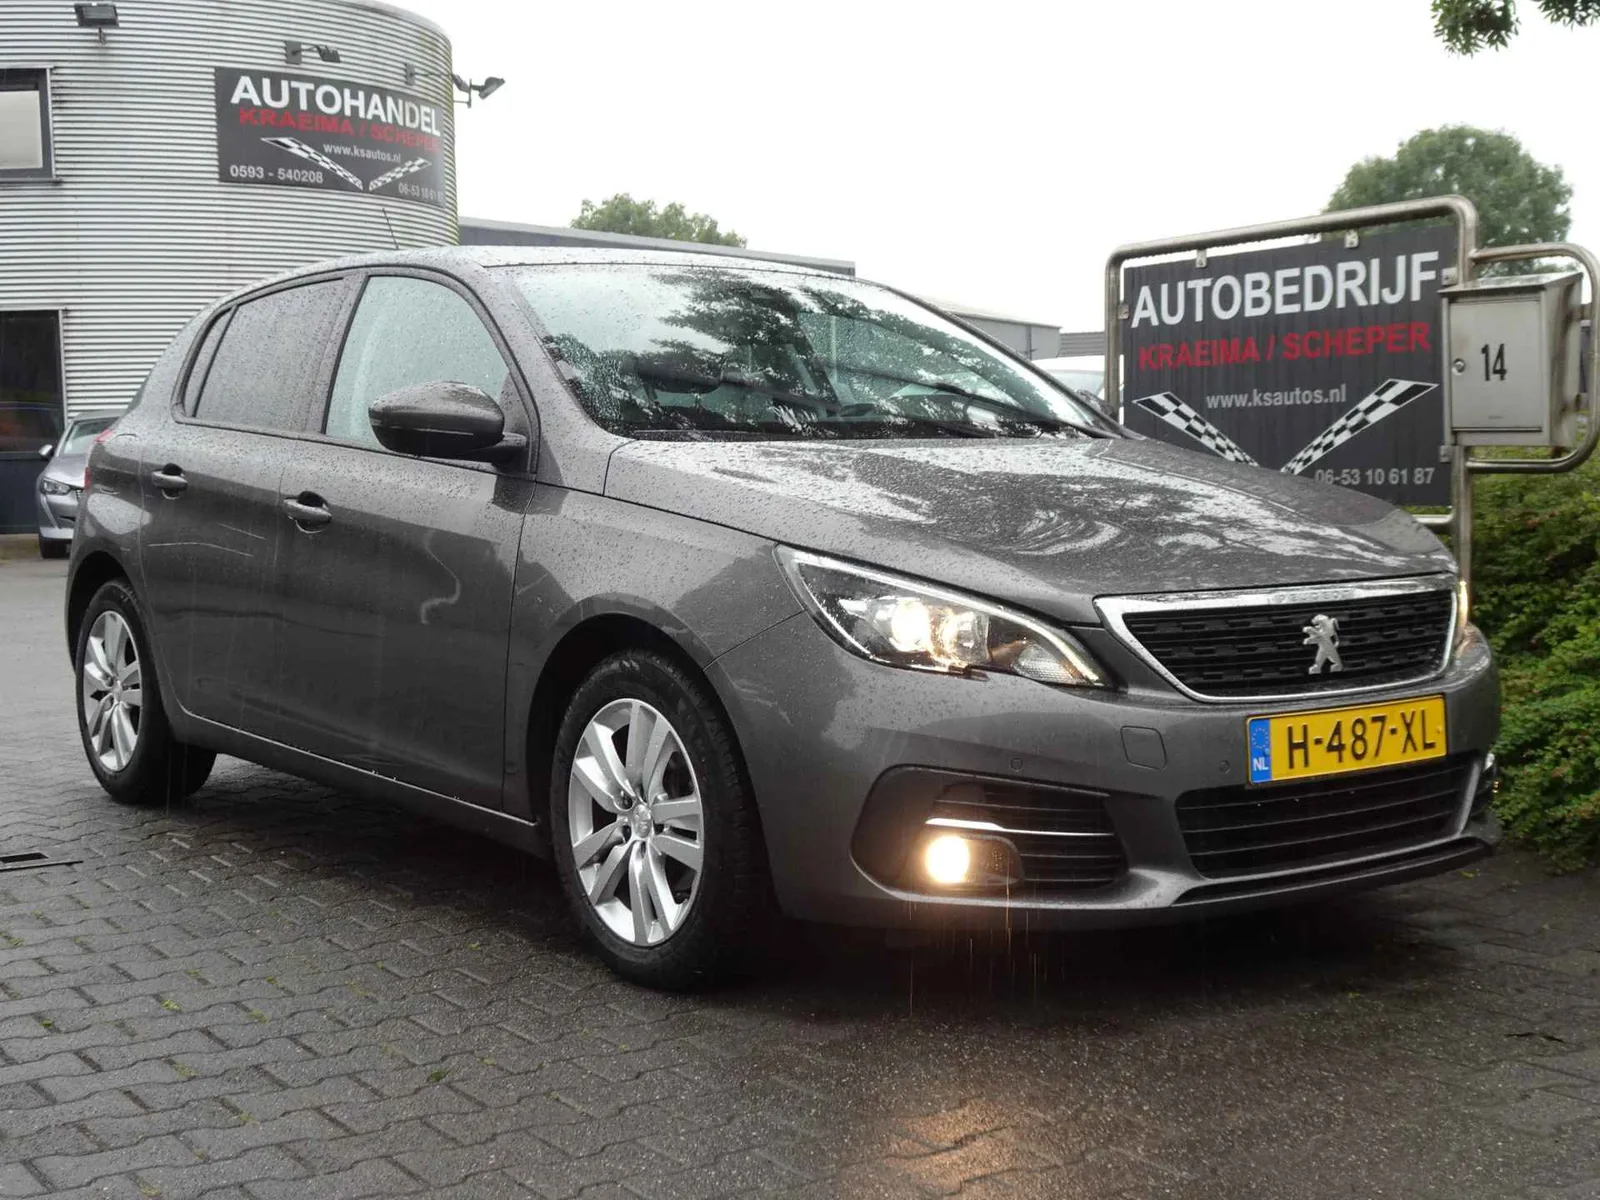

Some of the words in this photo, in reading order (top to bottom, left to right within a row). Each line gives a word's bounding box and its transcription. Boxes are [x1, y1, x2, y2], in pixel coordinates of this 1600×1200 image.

[230, 75, 441, 137] AUTOHANDEL
[239, 107, 355, 137] KRAEIMA
[323, 142, 401, 162] www.ksautos.nl
[230, 164, 264, 179] 0593
[277, 168, 323, 184] 540208
[1131, 250, 1439, 328] AUTOBEDRIJF
[1138, 337, 1260, 371] KRAEIMA
[1282, 321, 1431, 361] SCHEPER
[1481, 343, 1508, 382] 14
[1206, 384, 1347, 409] www.ksautos.nl
[1315, 469, 1360, 486] 06-53
[1365, 468, 1385, 485] 10
[1388, 468, 1408, 485] 61
[1413, 467, 1435, 485] 87
[1287, 709, 1436, 769] H-487-XL
[1253, 756, 1269, 772] NL
